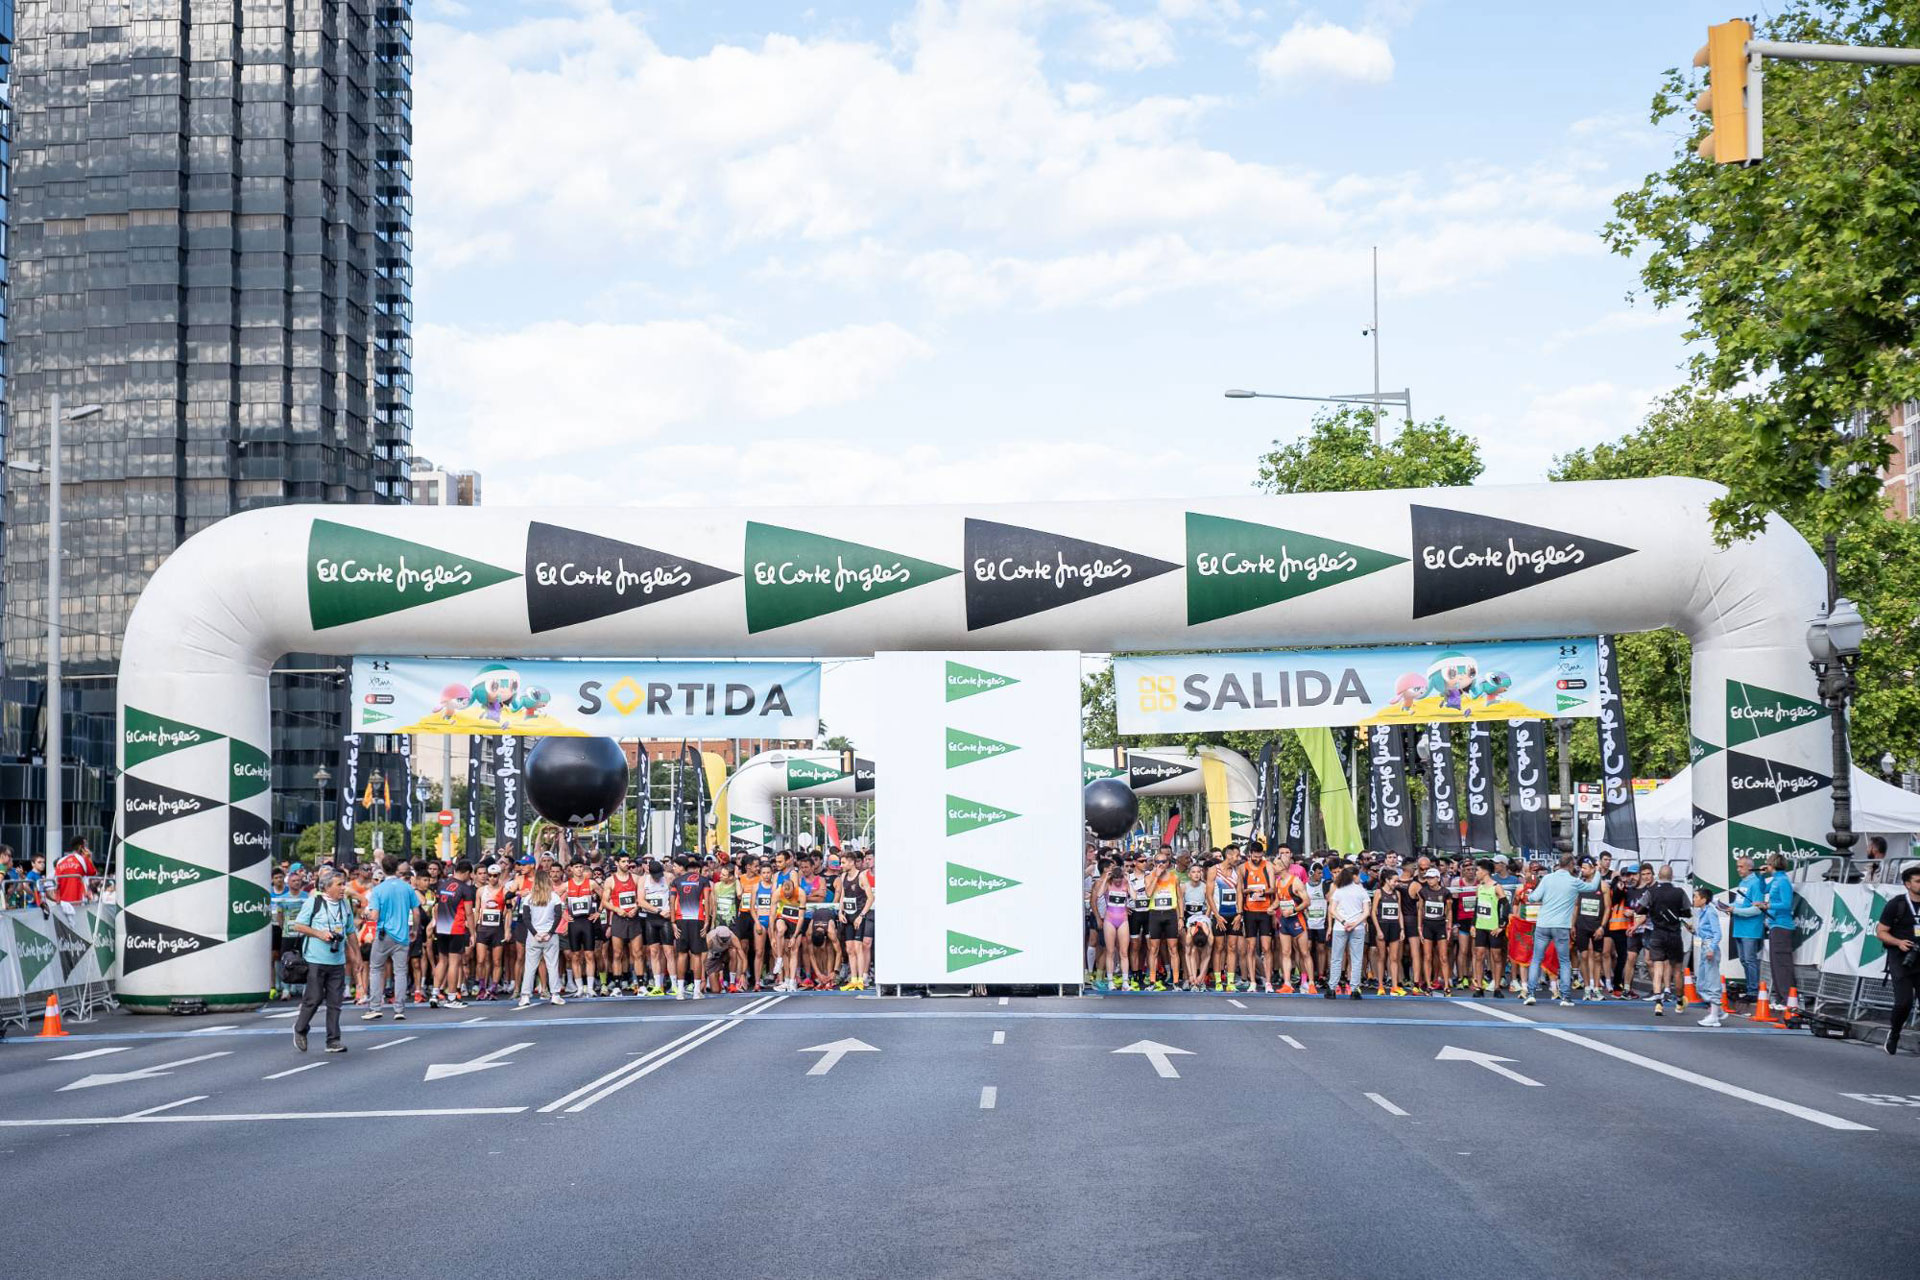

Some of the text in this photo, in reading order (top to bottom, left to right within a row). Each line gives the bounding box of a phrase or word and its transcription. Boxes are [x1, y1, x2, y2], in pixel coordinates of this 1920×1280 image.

[1423, 537, 1585, 576] El Corte Inglés
[973, 551, 1132, 589] El Corte Inglés
[1197, 544, 1357, 583] El Corte Inglés
[316, 555, 472, 592] El Corte Inglés
[535, 558, 691, 594] El Corte Inglés
[754, 555, 910, 592] El Corte Inglés
[577, 675, 793, 716] SORTIDA
[1183, 668, 1371, 712] SALIDA
[1731, 706, 1742, 719] El
[1743, 706, 1774, 718] Corte
[126, 730, 134, 743] El
[134, 730, 156, 743] Corte
[234, 763, 243, 776] El
[1731, 776, 1743, 789] El
[1744, 777, 1775, 789] Corte
[126, 799, 134, 812] El
[134, 799, 157, 811] Corte
[233, 832, 243, 845] El
[126, 868, 133, 880] El
[134, 868, 156, 881] Corte
[232, 901, 243, 914] El
[126, 936, 134, 949] El
[134, 937, 156, 949] Corte
